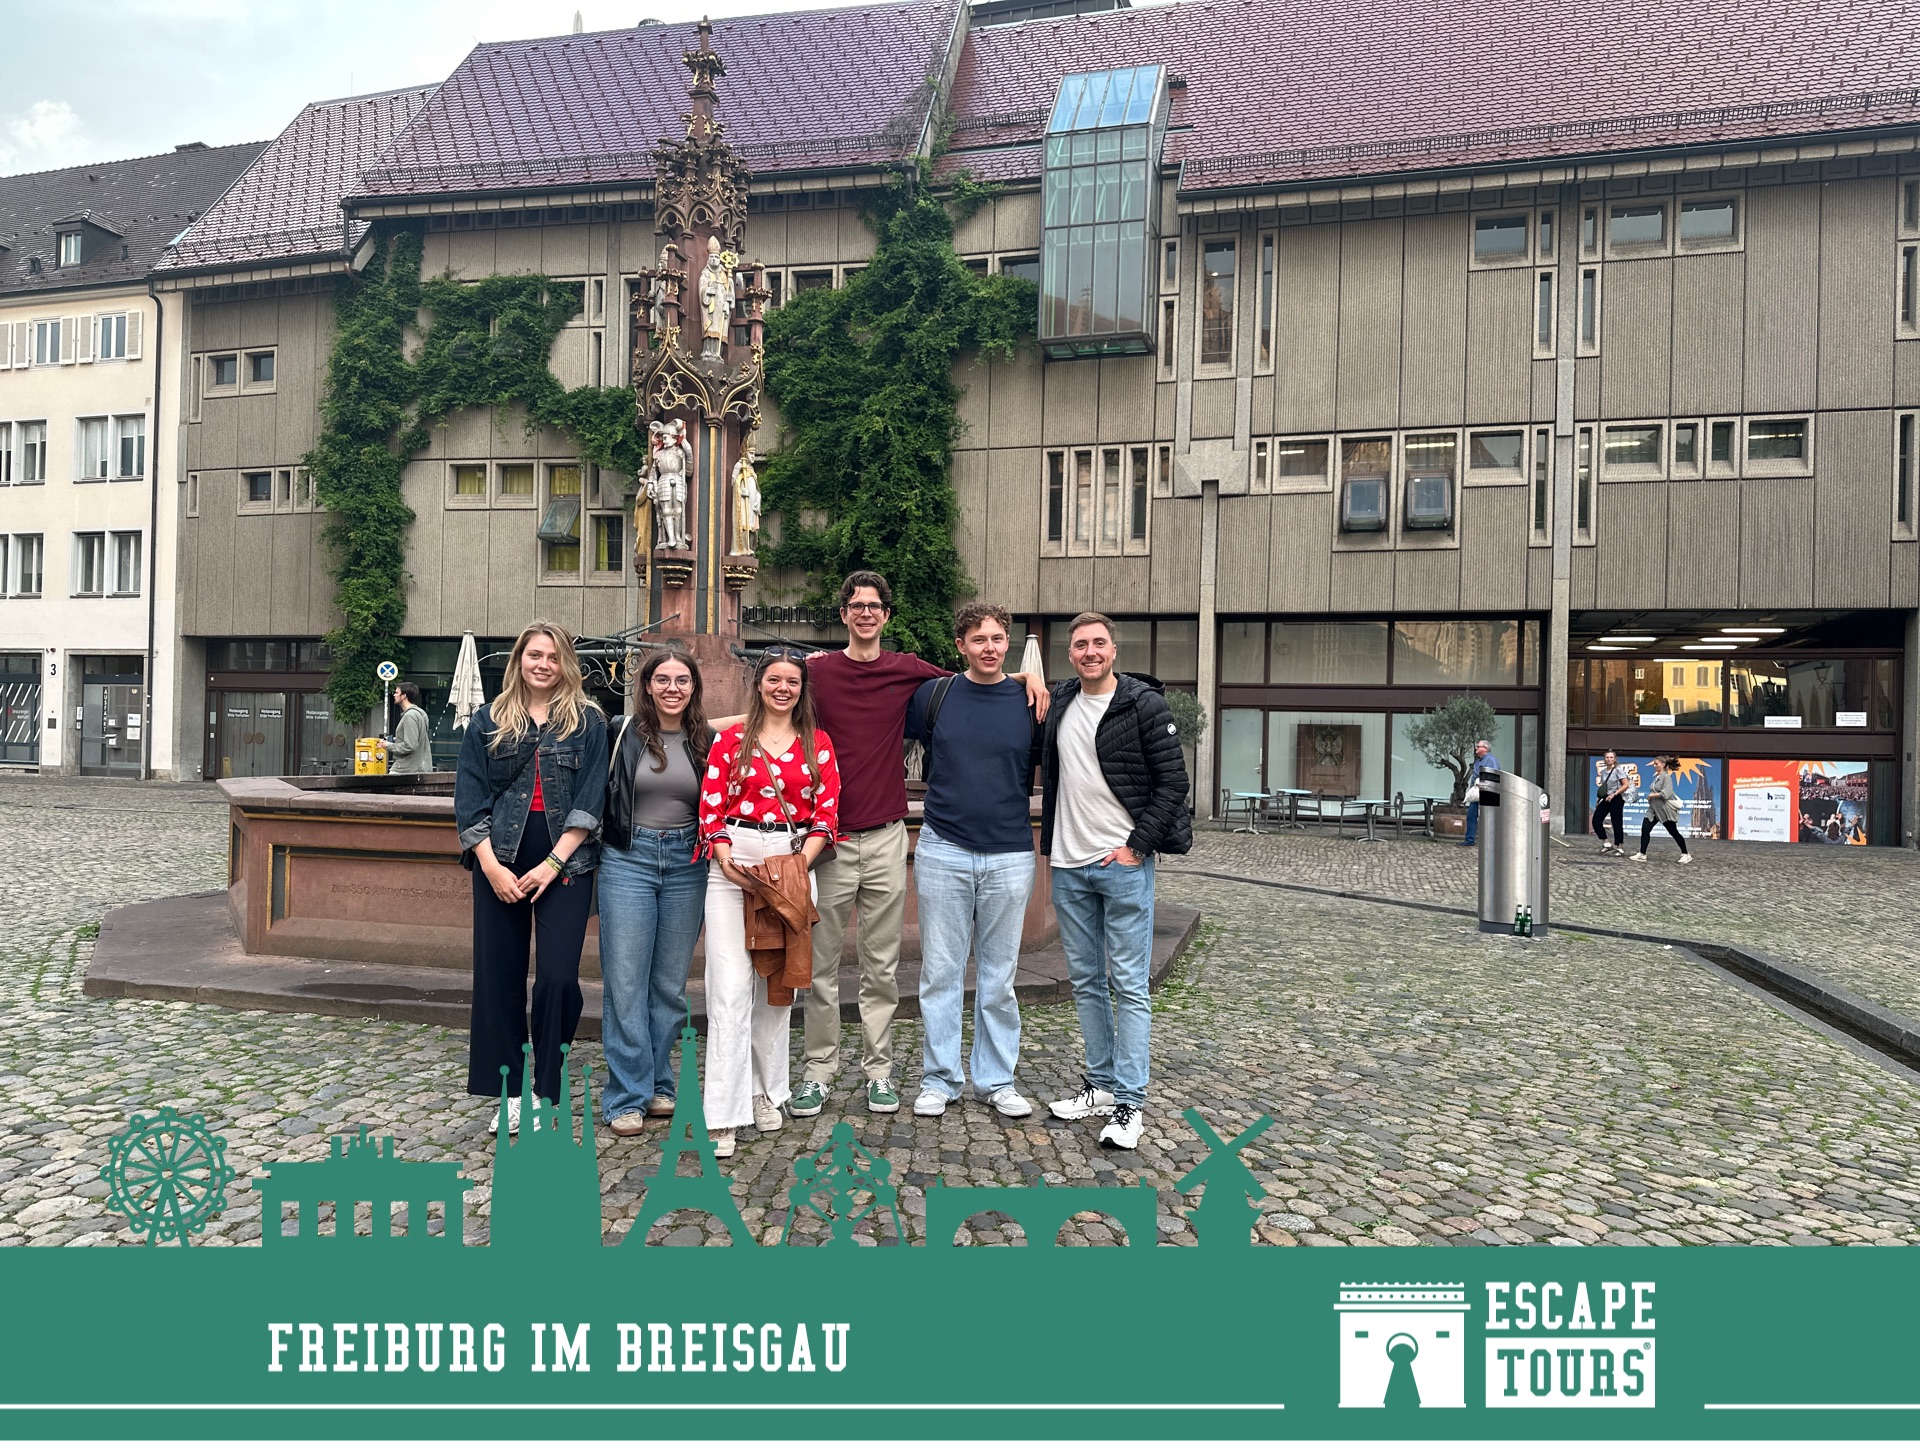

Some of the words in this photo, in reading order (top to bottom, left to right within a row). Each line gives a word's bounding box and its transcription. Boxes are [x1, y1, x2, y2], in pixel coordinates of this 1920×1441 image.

[742, 606, 842, 629] euninge
[50, 663, 57, 676] 3
[432, 877, 469, 888] 1970
